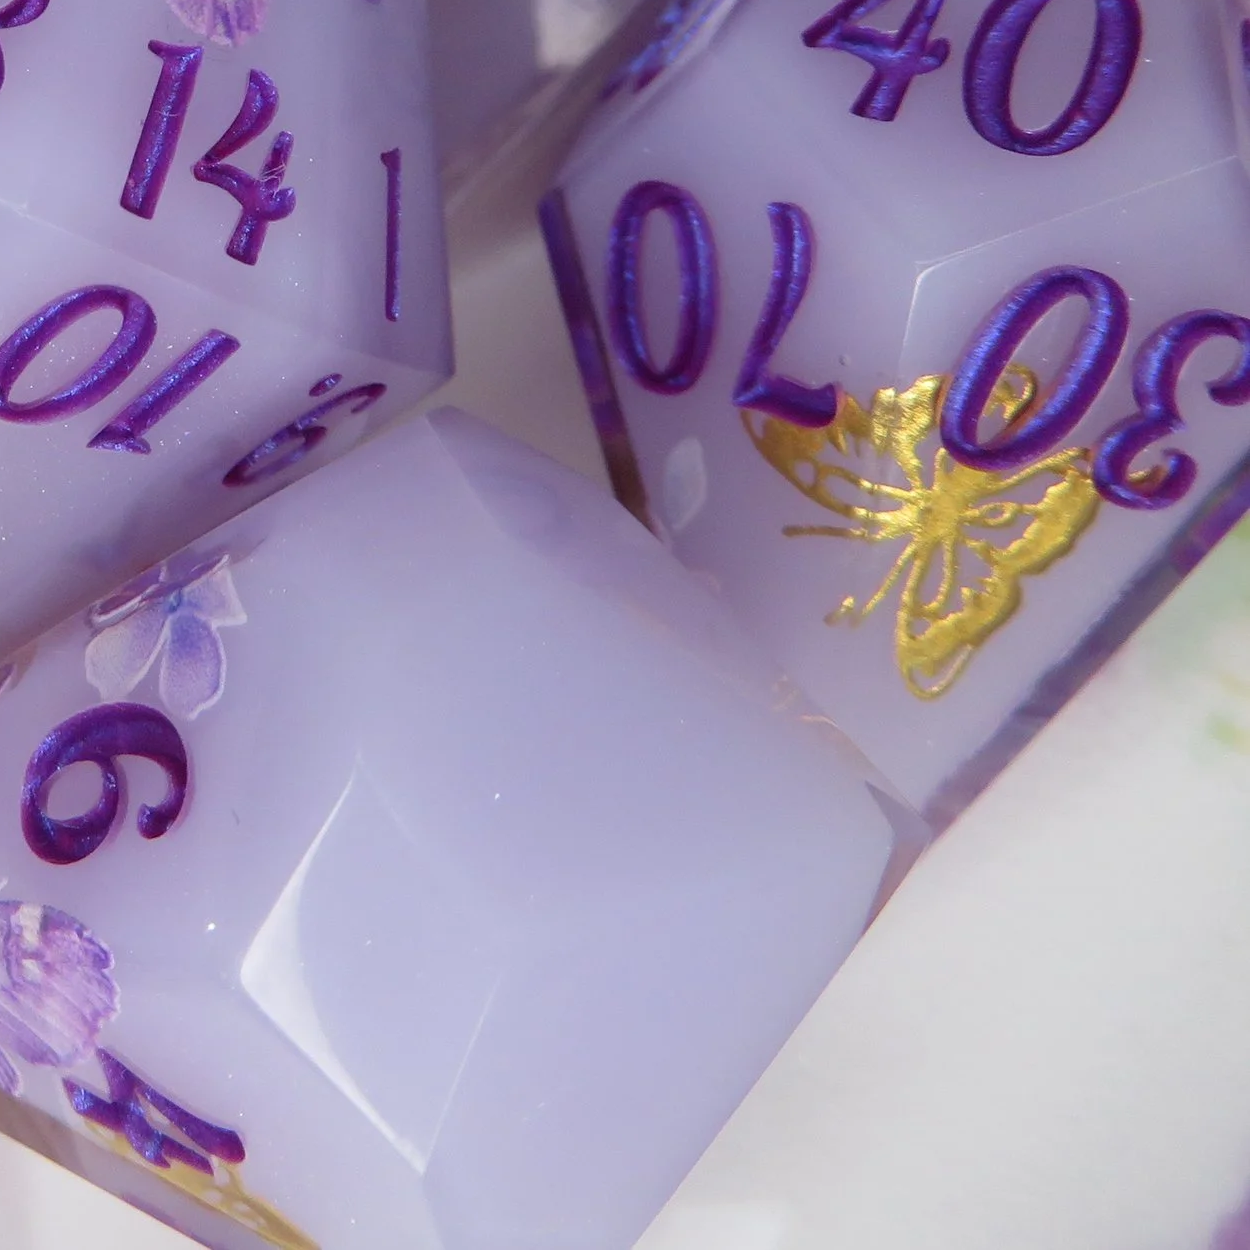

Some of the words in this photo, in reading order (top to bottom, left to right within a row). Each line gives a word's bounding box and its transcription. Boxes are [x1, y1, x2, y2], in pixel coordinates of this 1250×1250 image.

[120, 41, 296, 266] 14
[606, 180, 841, 428] 70
[940, 264, 1250, 511] 30
[62, 1047, 246, 1176] 4
